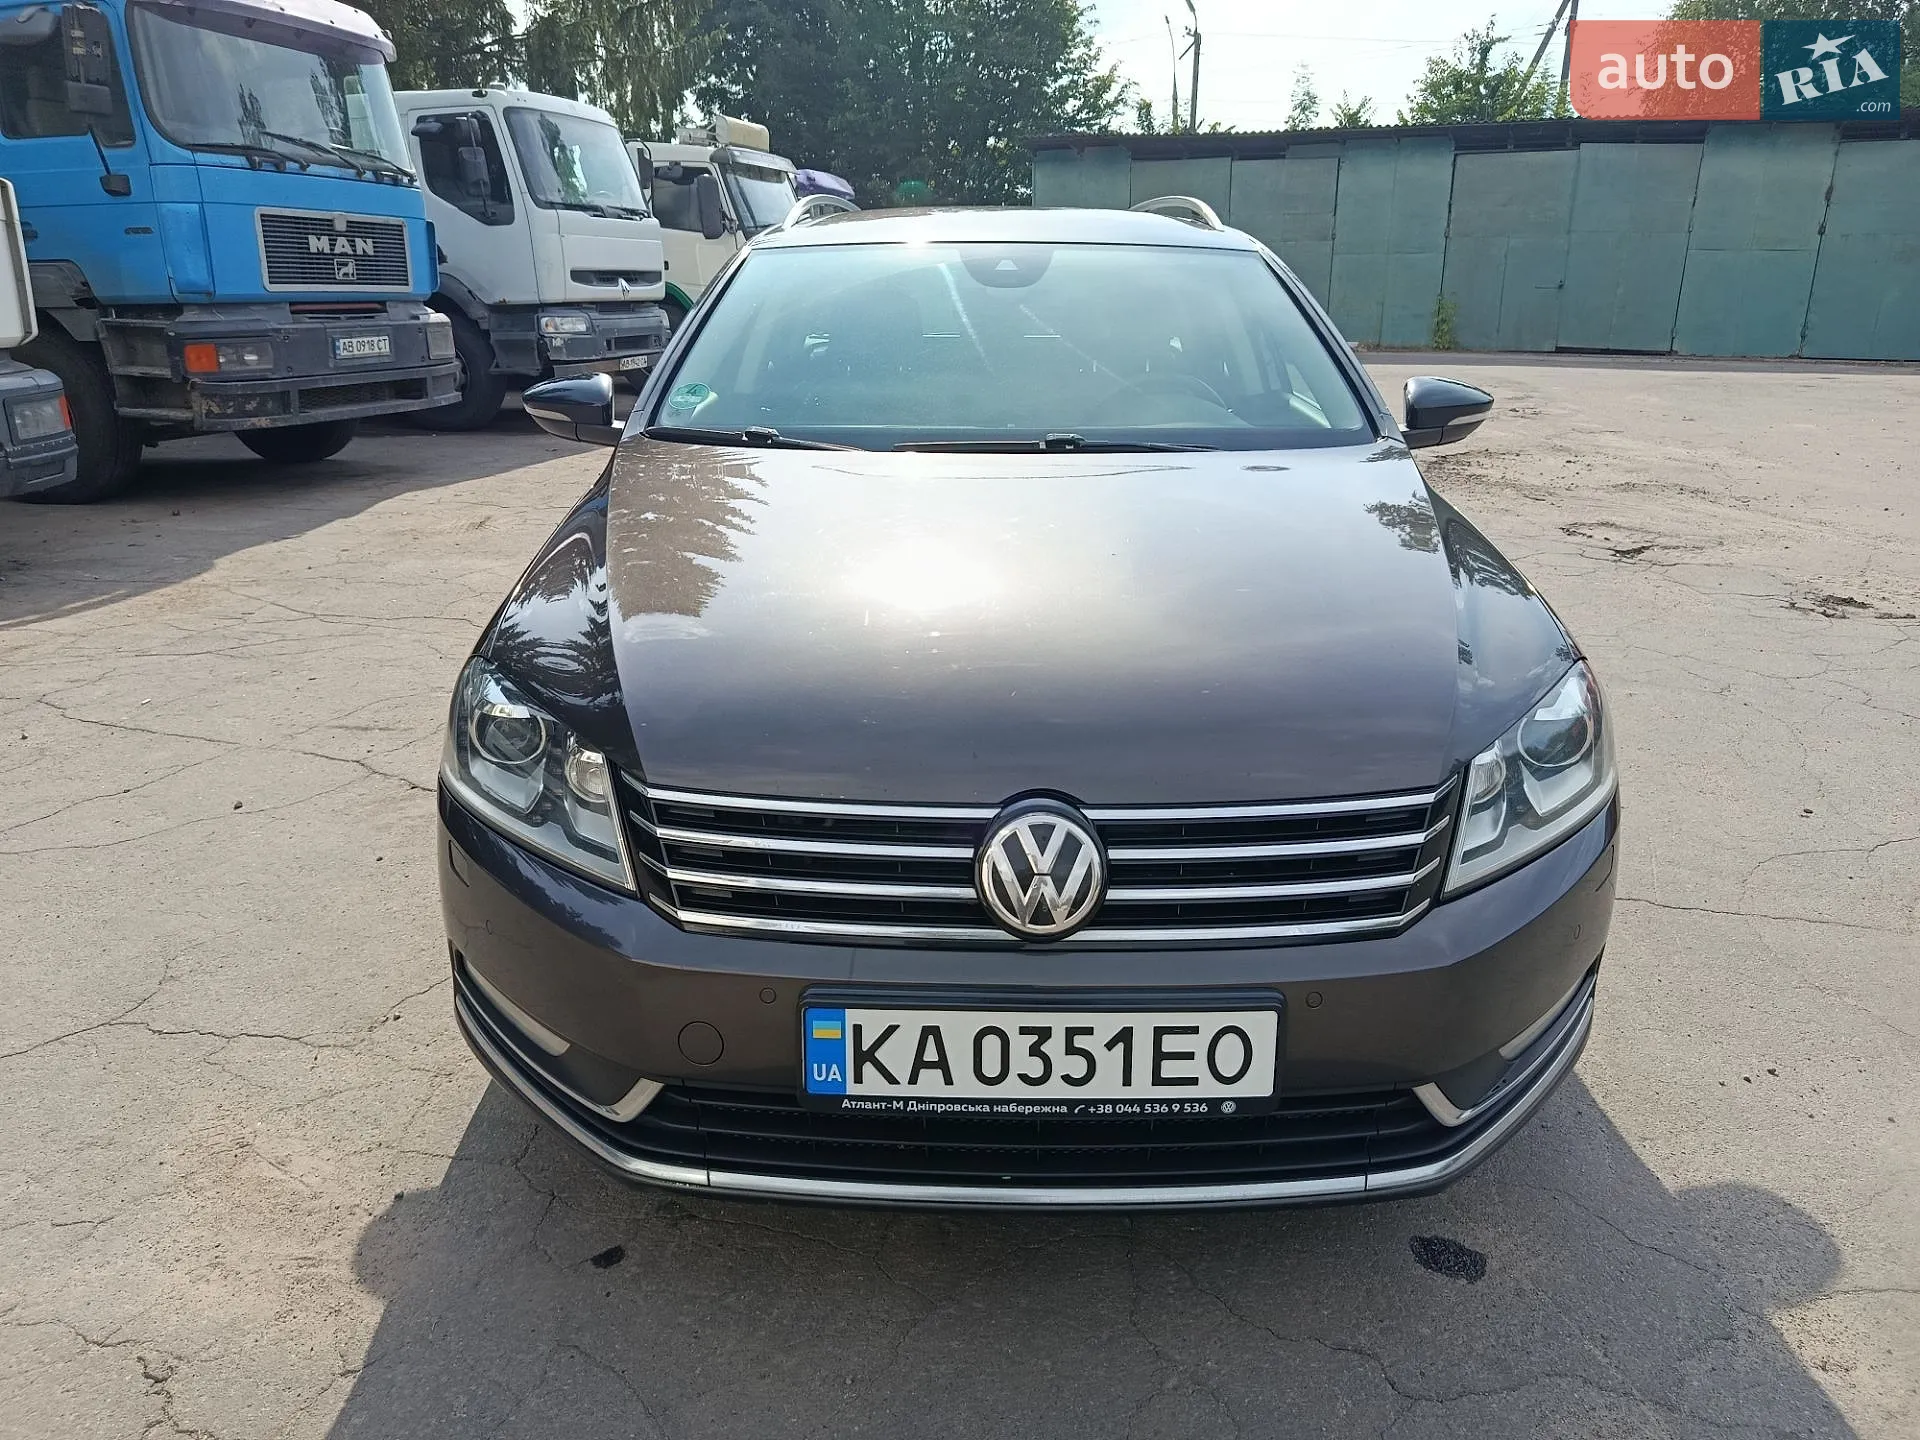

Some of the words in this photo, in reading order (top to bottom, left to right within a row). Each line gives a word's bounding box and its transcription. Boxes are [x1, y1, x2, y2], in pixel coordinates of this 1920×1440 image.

[308, 235, 374, 255] MAN
[813, 1063, 842, 1081] UA
[841, 1098, 904, 1111] Атлант-М
[906, 1101, 990, 1114] Дніпровська
[993, 1103, 1068, 1114] набережна
[1088, 1103, 1113, 1114] +38
[1116, 1103, 1141, 1113] 044
[1144, 1103, 1169, 1113] 536
[1171, 1103, 1180, 1113] 9
[1183, 1102, 1208, 1113] 536
